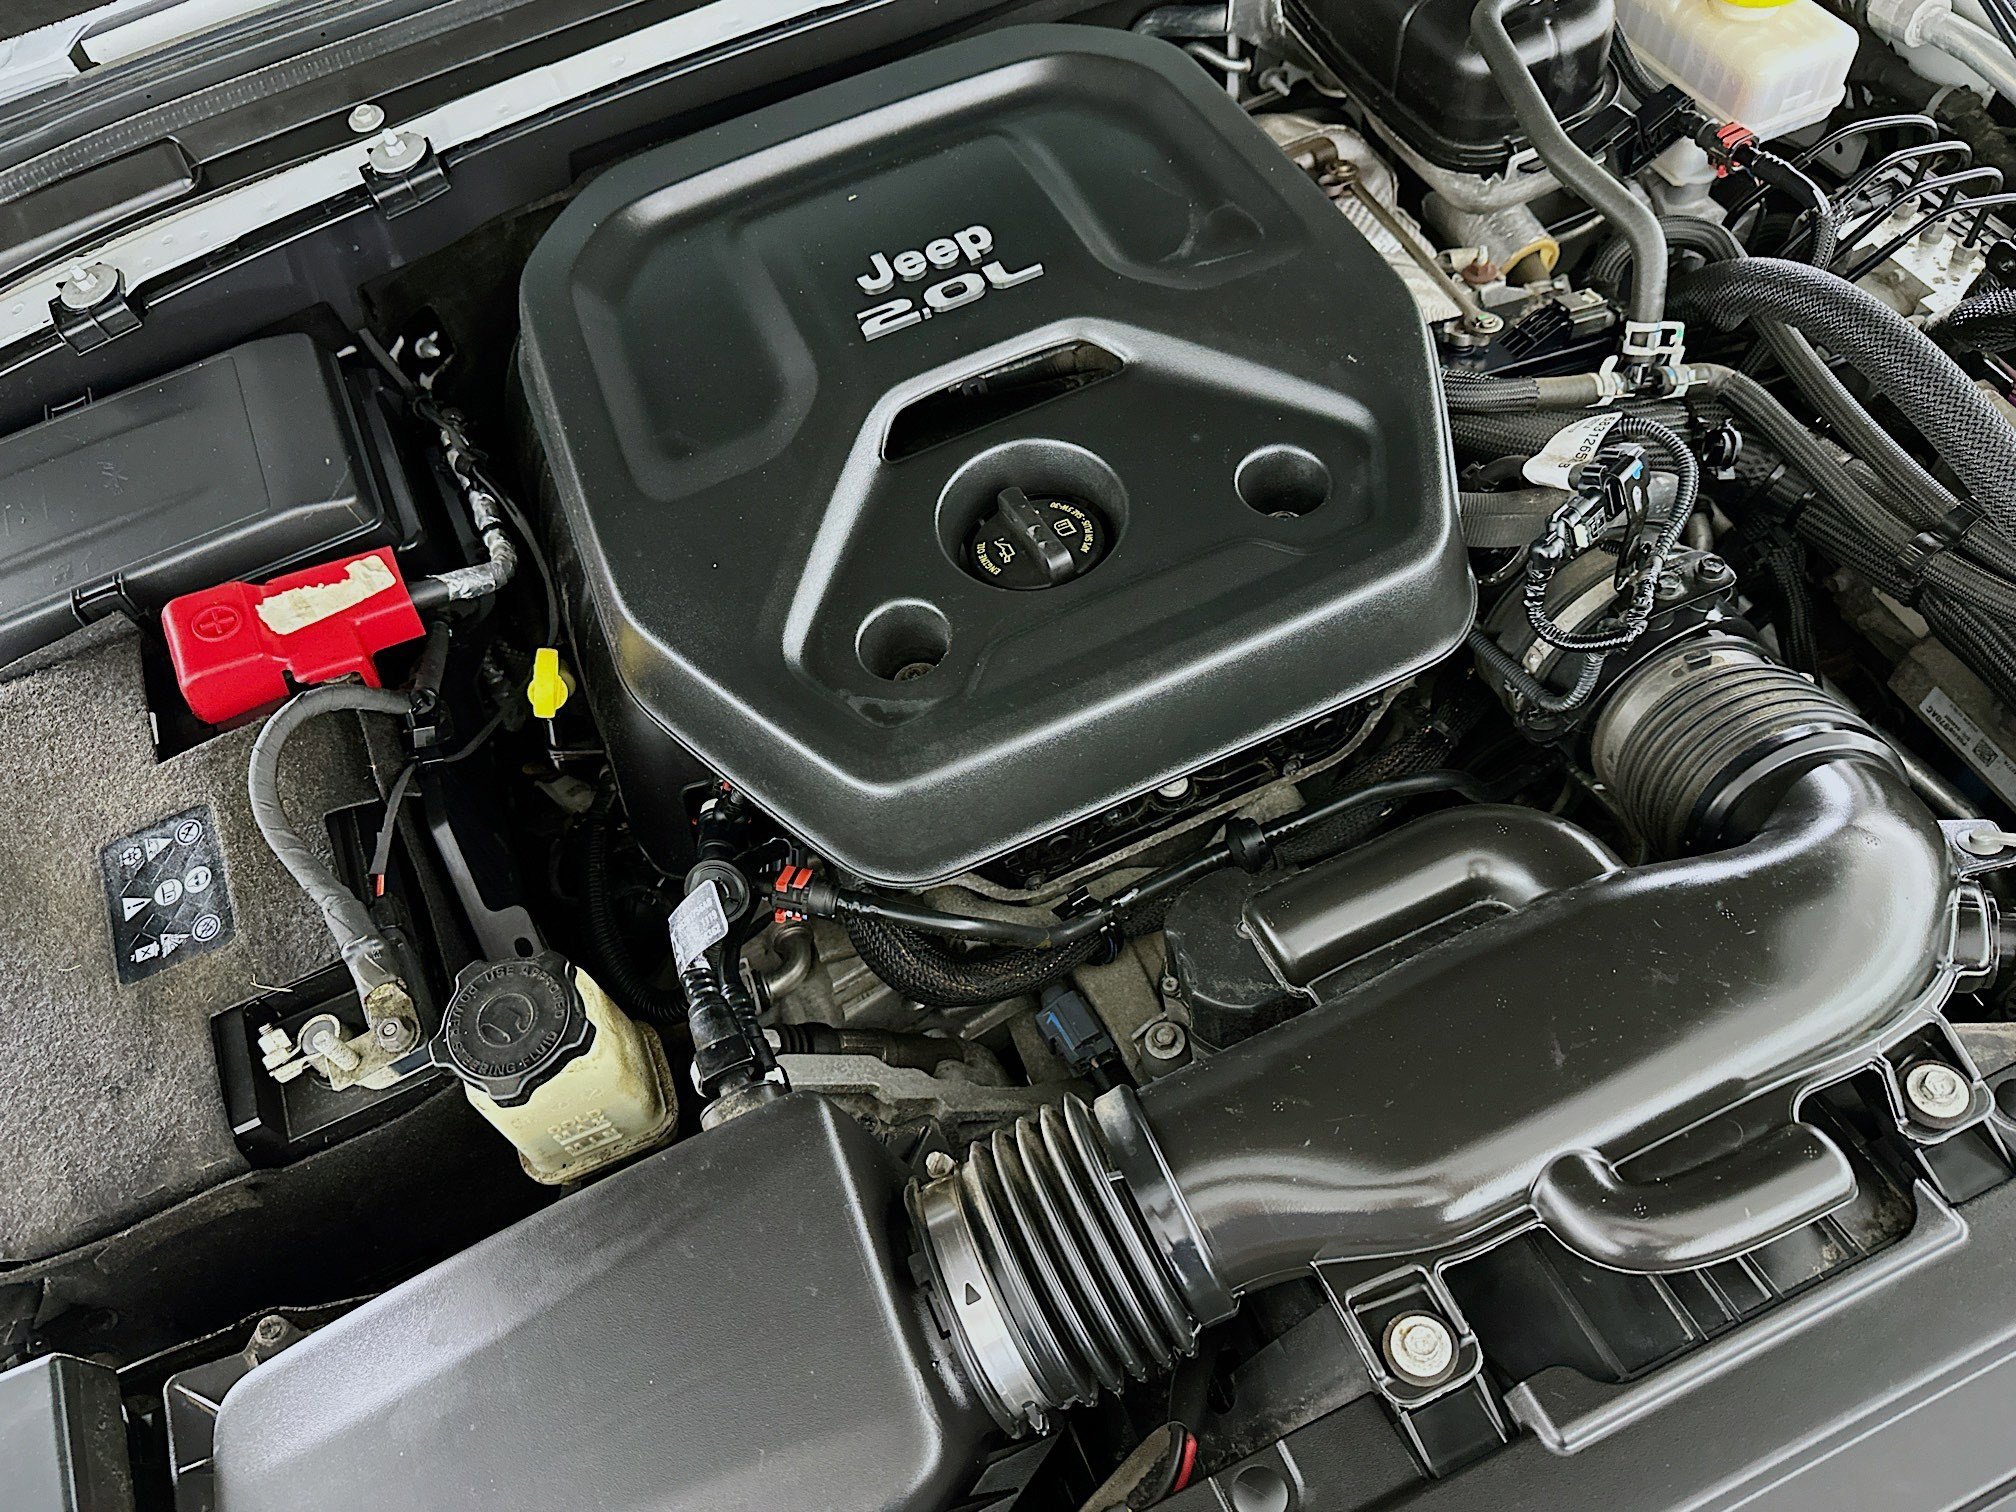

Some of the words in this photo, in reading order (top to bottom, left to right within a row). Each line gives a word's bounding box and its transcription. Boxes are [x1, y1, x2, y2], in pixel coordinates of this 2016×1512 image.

[857, 224, 993, 296] Jeep
[856, 261, 1044, 342] 2.0L
[976, 542, 986, 554] OIL
[979, 554, 1001, 575] ENGINE
[450, 985, 478, 1035] POWER
[485, 966, 515, 982] USE
[520, 966, 567, 1019] APPROVED
[453, 1041, 516, 1076] STEERING
[522, 1031, 559, 1067] FLUID
